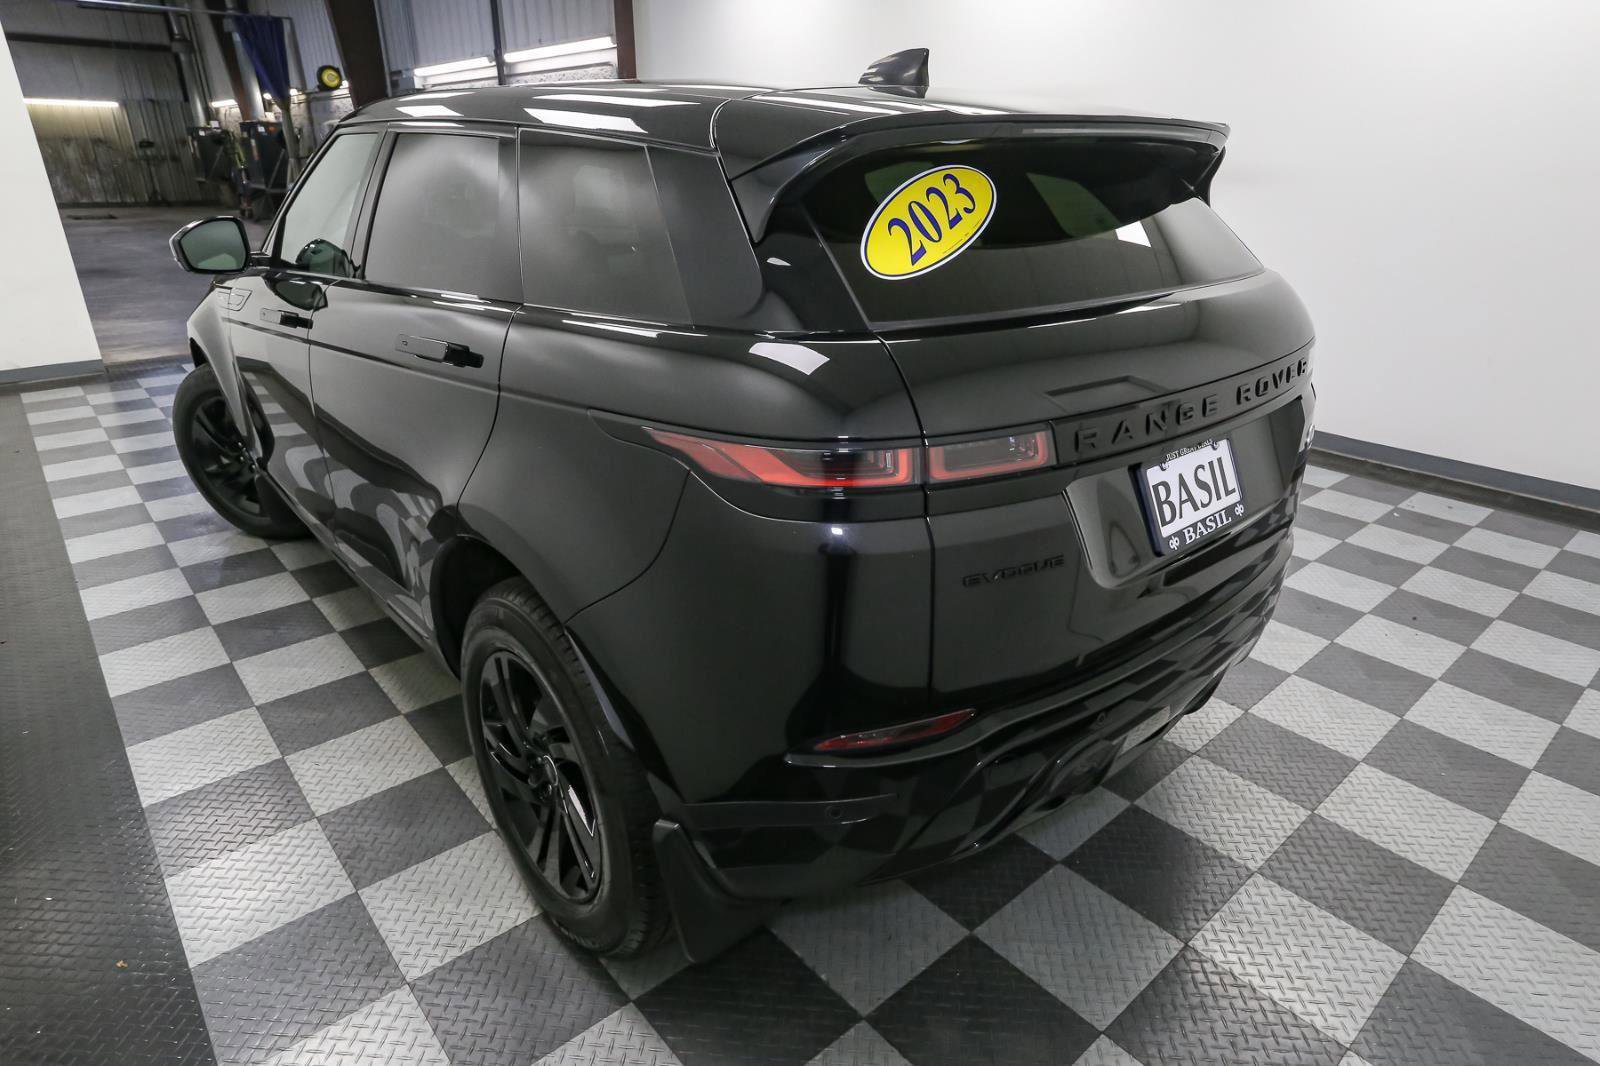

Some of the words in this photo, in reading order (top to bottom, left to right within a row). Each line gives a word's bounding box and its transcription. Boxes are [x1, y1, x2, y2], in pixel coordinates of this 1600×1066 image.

[887, 173, 976, 267] 2023
[1074, 394, 1218, 452] RANGE
[1236, 357, 1307, 405] ROVER
[1152, 456, 1236, 528] BASIL
[1182, 509, 1232, 545] BASIL
